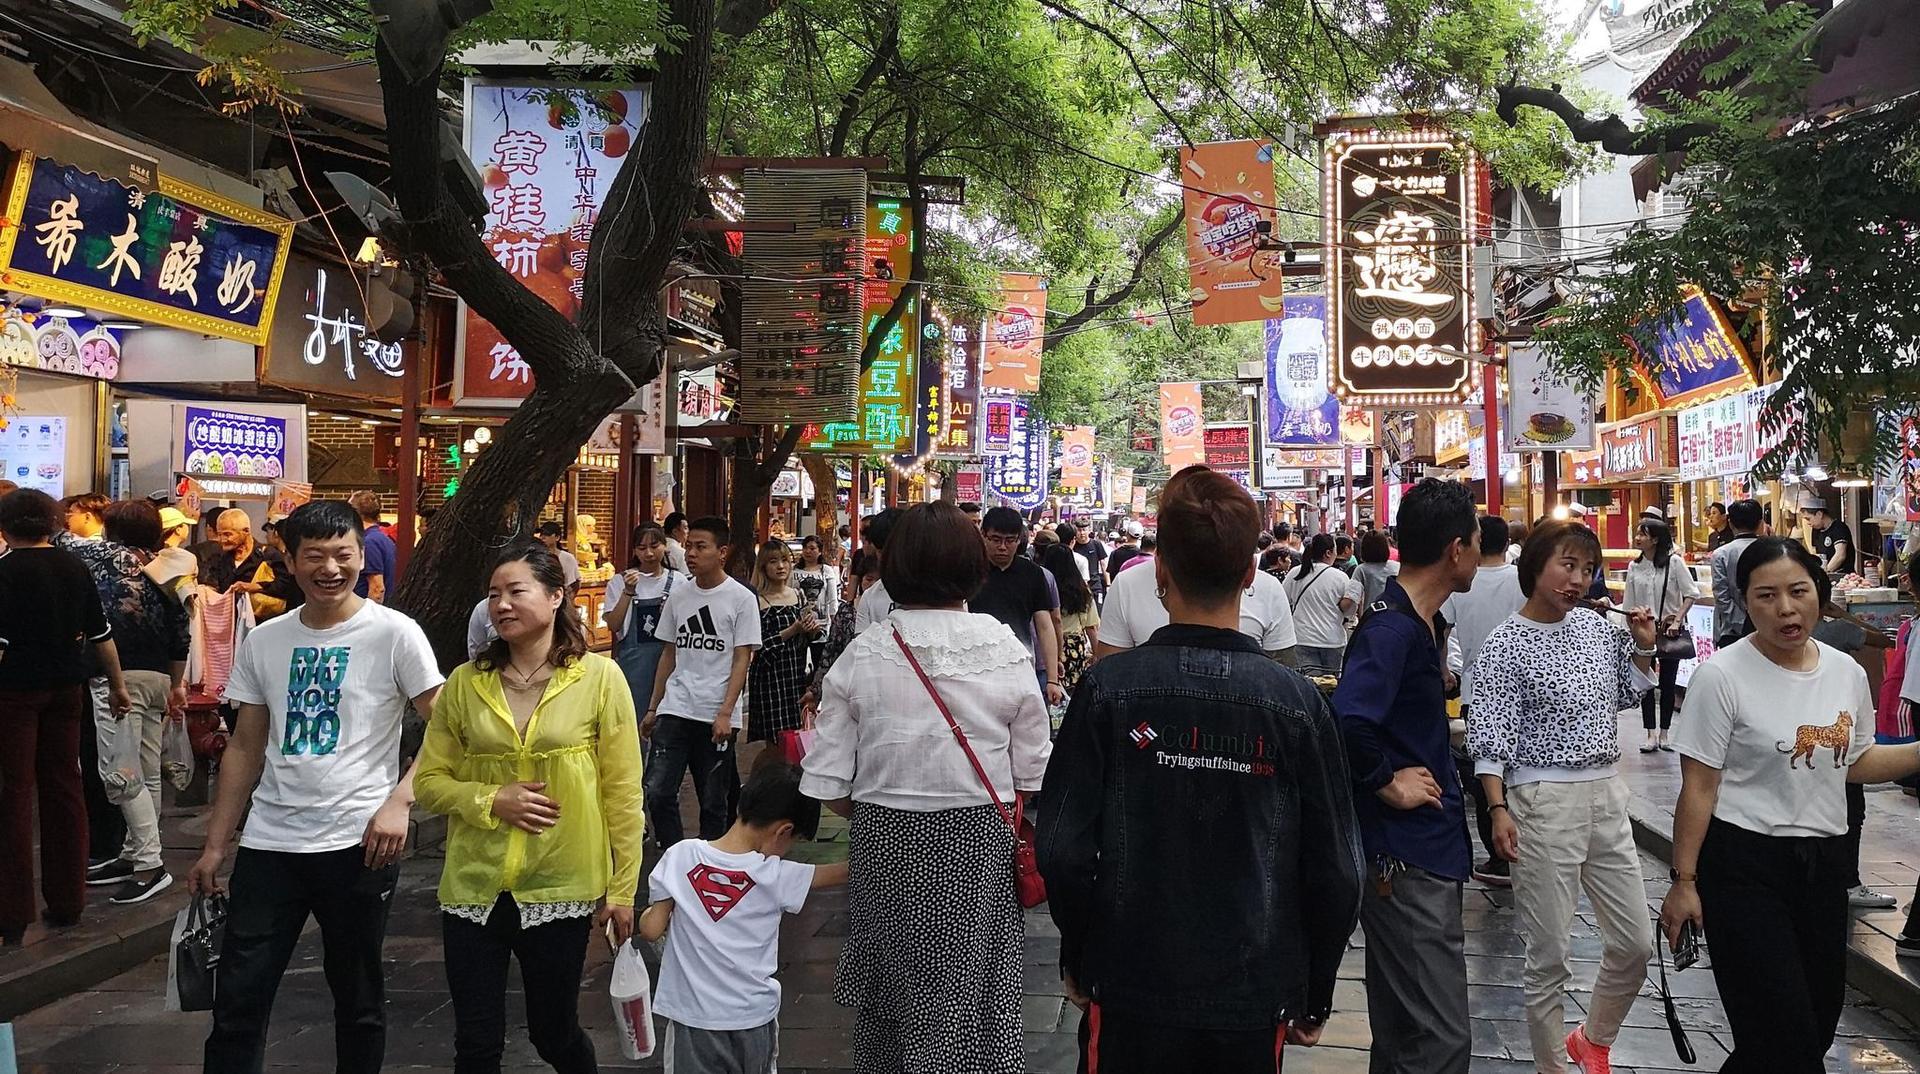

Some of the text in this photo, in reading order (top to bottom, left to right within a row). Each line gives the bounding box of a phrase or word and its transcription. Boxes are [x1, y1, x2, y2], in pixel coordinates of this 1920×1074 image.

[1680, 430, 1707, 465] 石榴汁
[1713, 422, 1743, 459] 酸梅汤
[676, 633, 725, 652] adidas
[1160, 724, 1279, 759] Columbia
